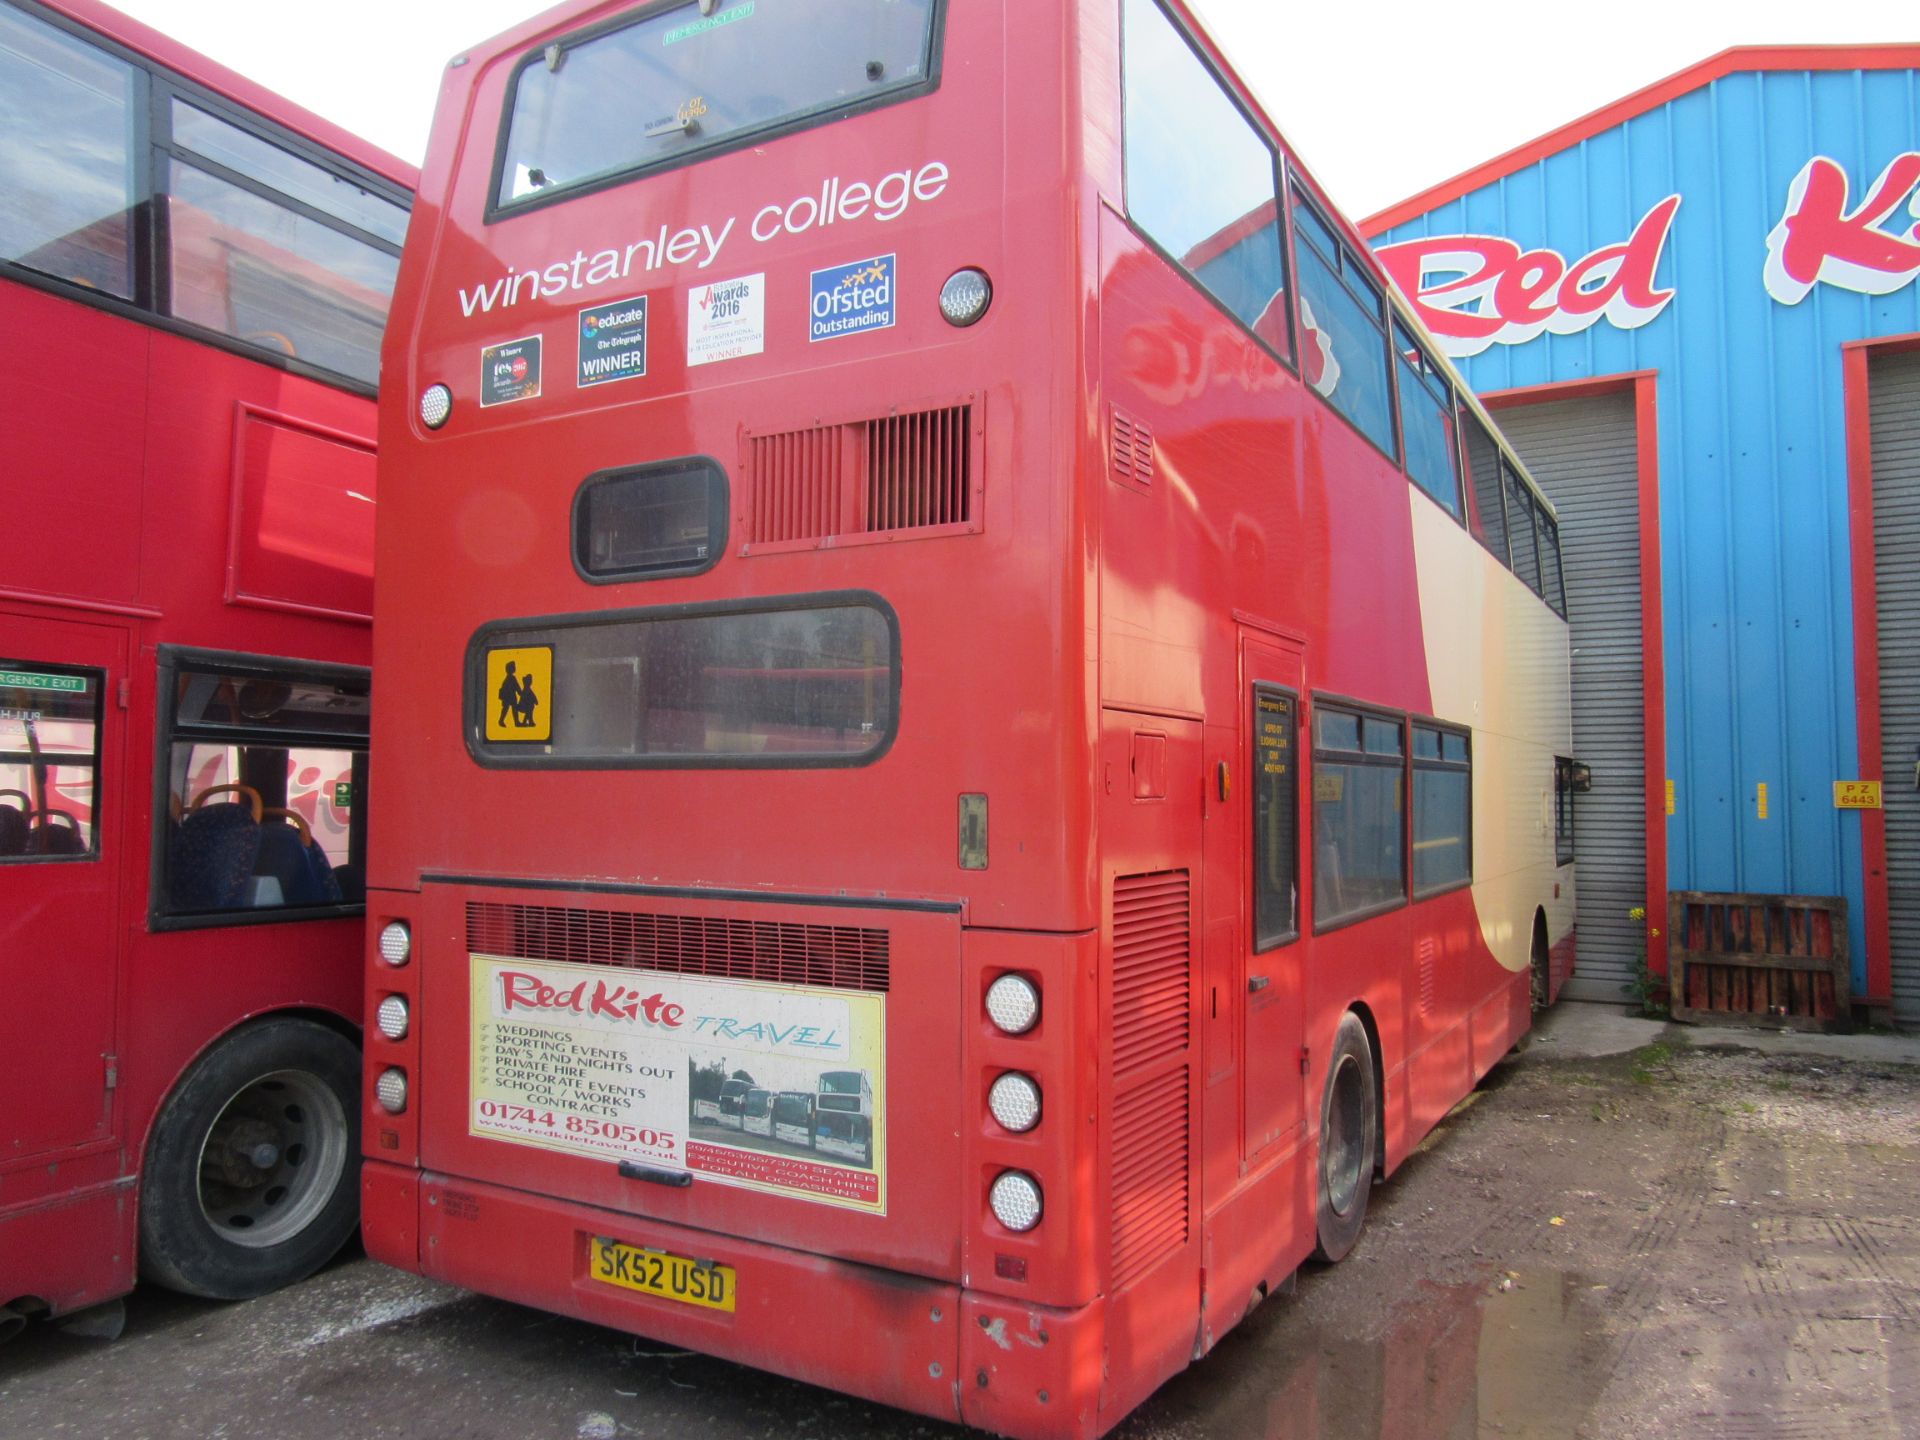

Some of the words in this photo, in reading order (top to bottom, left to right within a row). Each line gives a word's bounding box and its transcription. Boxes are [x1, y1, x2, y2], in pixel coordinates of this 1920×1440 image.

[459, 217, 736, 318] winstanley
[751, 161, 949, 242] college
[1371, 194, 1682, 350] Red
[698, 282, 750, 311] Awards
[711, 299, 740, 320] 2016
[813, 275, 889, 318] Ofsted
[598, 308, 643, 329] educate
[813, 310, 889, 335] Outstanding
[582, 350, 642, 377] WINNER
[705, 346, 743, 361] WINNER
[51, 678, 78, 689] EXIT
[1841, 795, 1875, 805] 6443
[499, 971, 587, 1014] Red
[590, 979, 685, 1029] Kite
[496, 1023, 573, 1042] WEDDINGS
[695, 1016, 842, 1048] TRAVEL
[495, 1034, 566, 1053] SPORTING
[571, 1044, 628, 1062] EVENTS
[495, 1045, 534, 1059] DAY'S
[539, 1052, 572, 1064] AND
[577, 1058, 633, 1074] NIGHTS
[639, 1065, 676, 1080] OUT
[495, 1056, 549, 1073] PRIVATE
[554, 1064, 587, 1078] HIRE
[495, 1067, 583, 1089] CORPORATE
[588, 1081, 646, 1099] EVENTS
[495, 1078, 554, 1096] SCHOOL
[574, 1090, 632, 1108] WORKS
[526, 1094, 618, 1118] CONTRACTS
[479, 1101, 556, 1128] 01744
[565, 1116, 675, 1150] 850505
[479, 1119, 680, 1161] www.redkitetravel.co.uk
[686, 1151, 771, 1174] EXECUTIVE
[775, 1165, 833, 1185] COACH
[836, 1179, 876, 1193] HIRE
[700, 1163, 733, 1175] FOR
[735, 1169, 758, 1180] ALL
[765, 1175, 862, 1199] OCCASIONS
[811, 1166, 877, 1184] SEATER
[600, 1246, 664, 1289] SK52
[671, 1262, 724, 1303] USD
